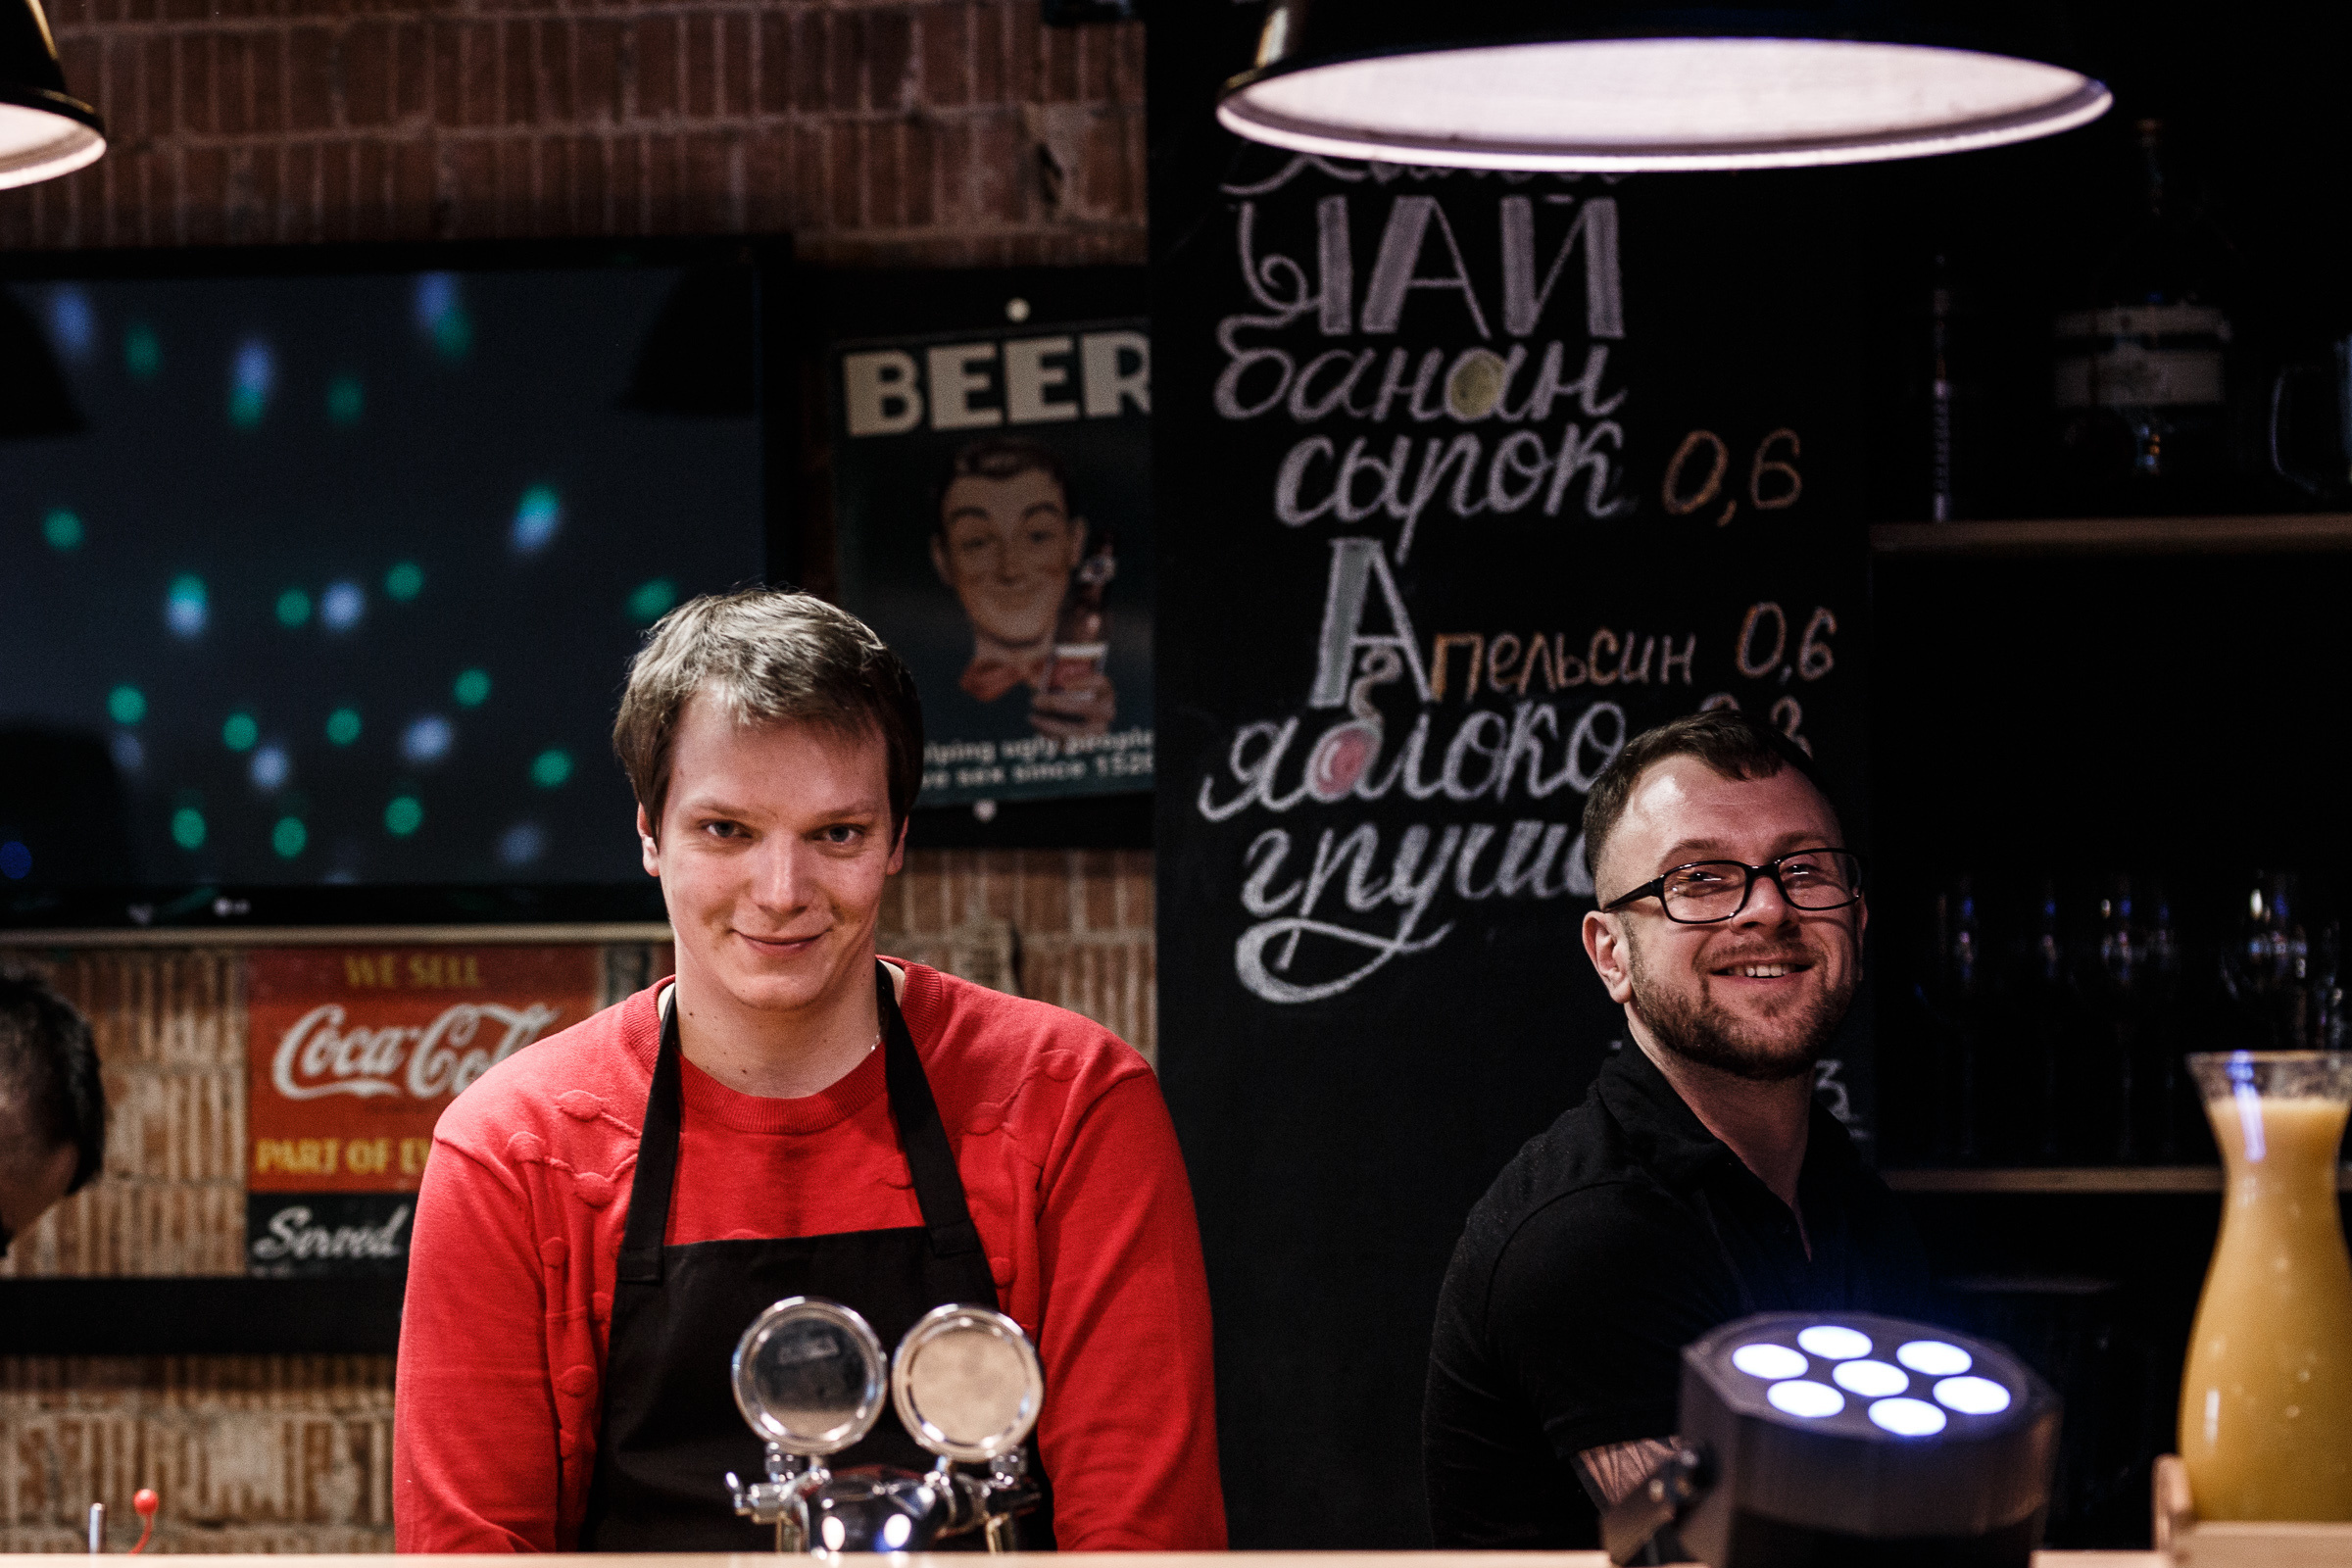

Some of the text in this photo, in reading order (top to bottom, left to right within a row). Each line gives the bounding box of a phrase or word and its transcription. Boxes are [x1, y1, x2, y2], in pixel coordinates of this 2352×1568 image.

[843, 330, 1152, 437] BEER
[1213, 312, 1628, 423] банан
[1273, 421, 1803, 566] сырок 0,6
[1735, 602, 1838, 685] 0,6
[345, 954, 479, 988] WE SELL
[256, 1137, 339, 1174] PART
[345, 1137, 390, 1174] OF
[252, 1204, 411, 1260] Served
